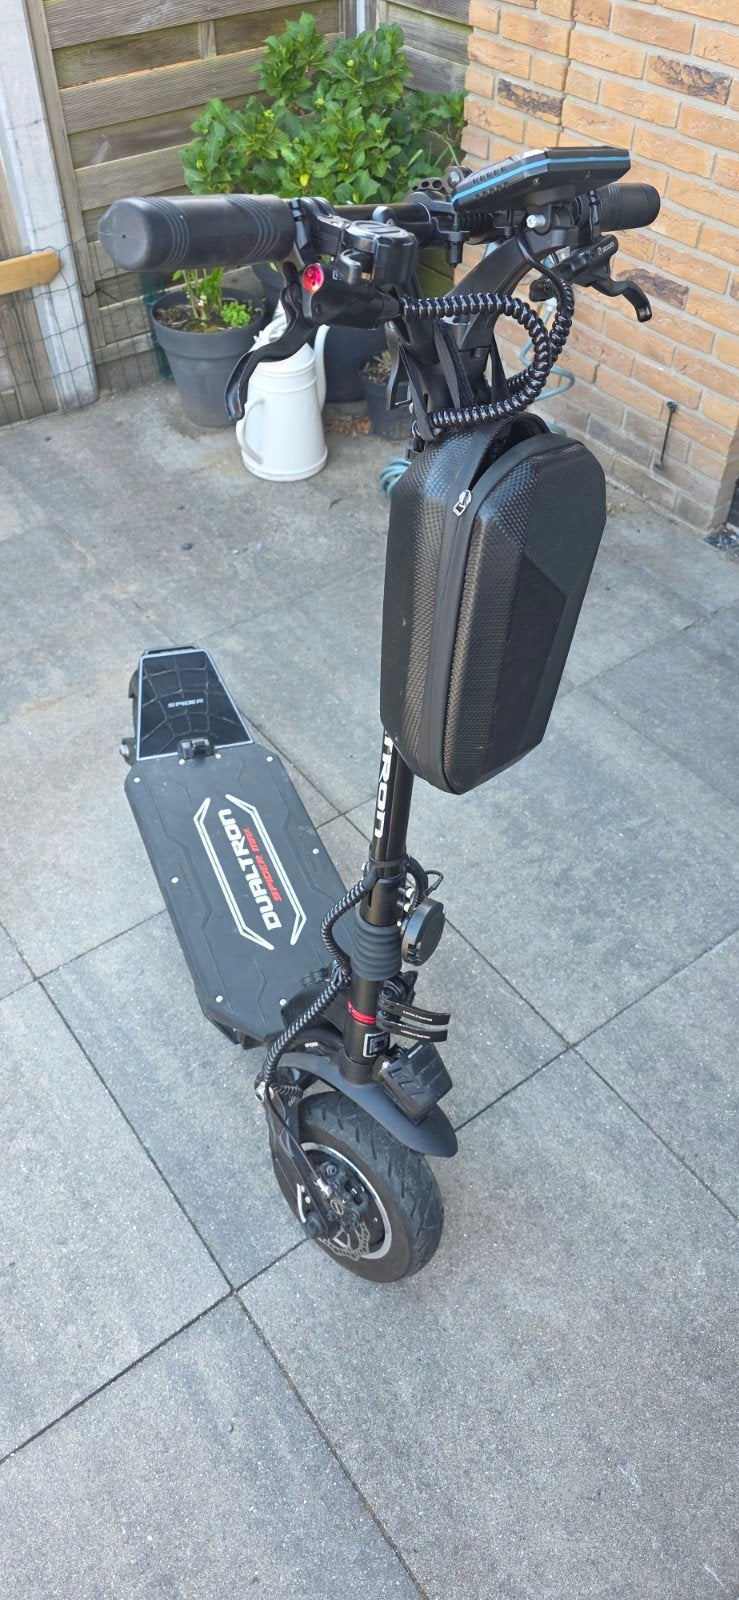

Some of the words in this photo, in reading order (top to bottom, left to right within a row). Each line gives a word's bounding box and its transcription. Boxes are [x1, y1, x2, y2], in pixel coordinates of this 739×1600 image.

[374, 731, 394, 838] TRON
[218, 808, 282, 931] DUALTRON
[255, 854, 282, 902] SPIDER
